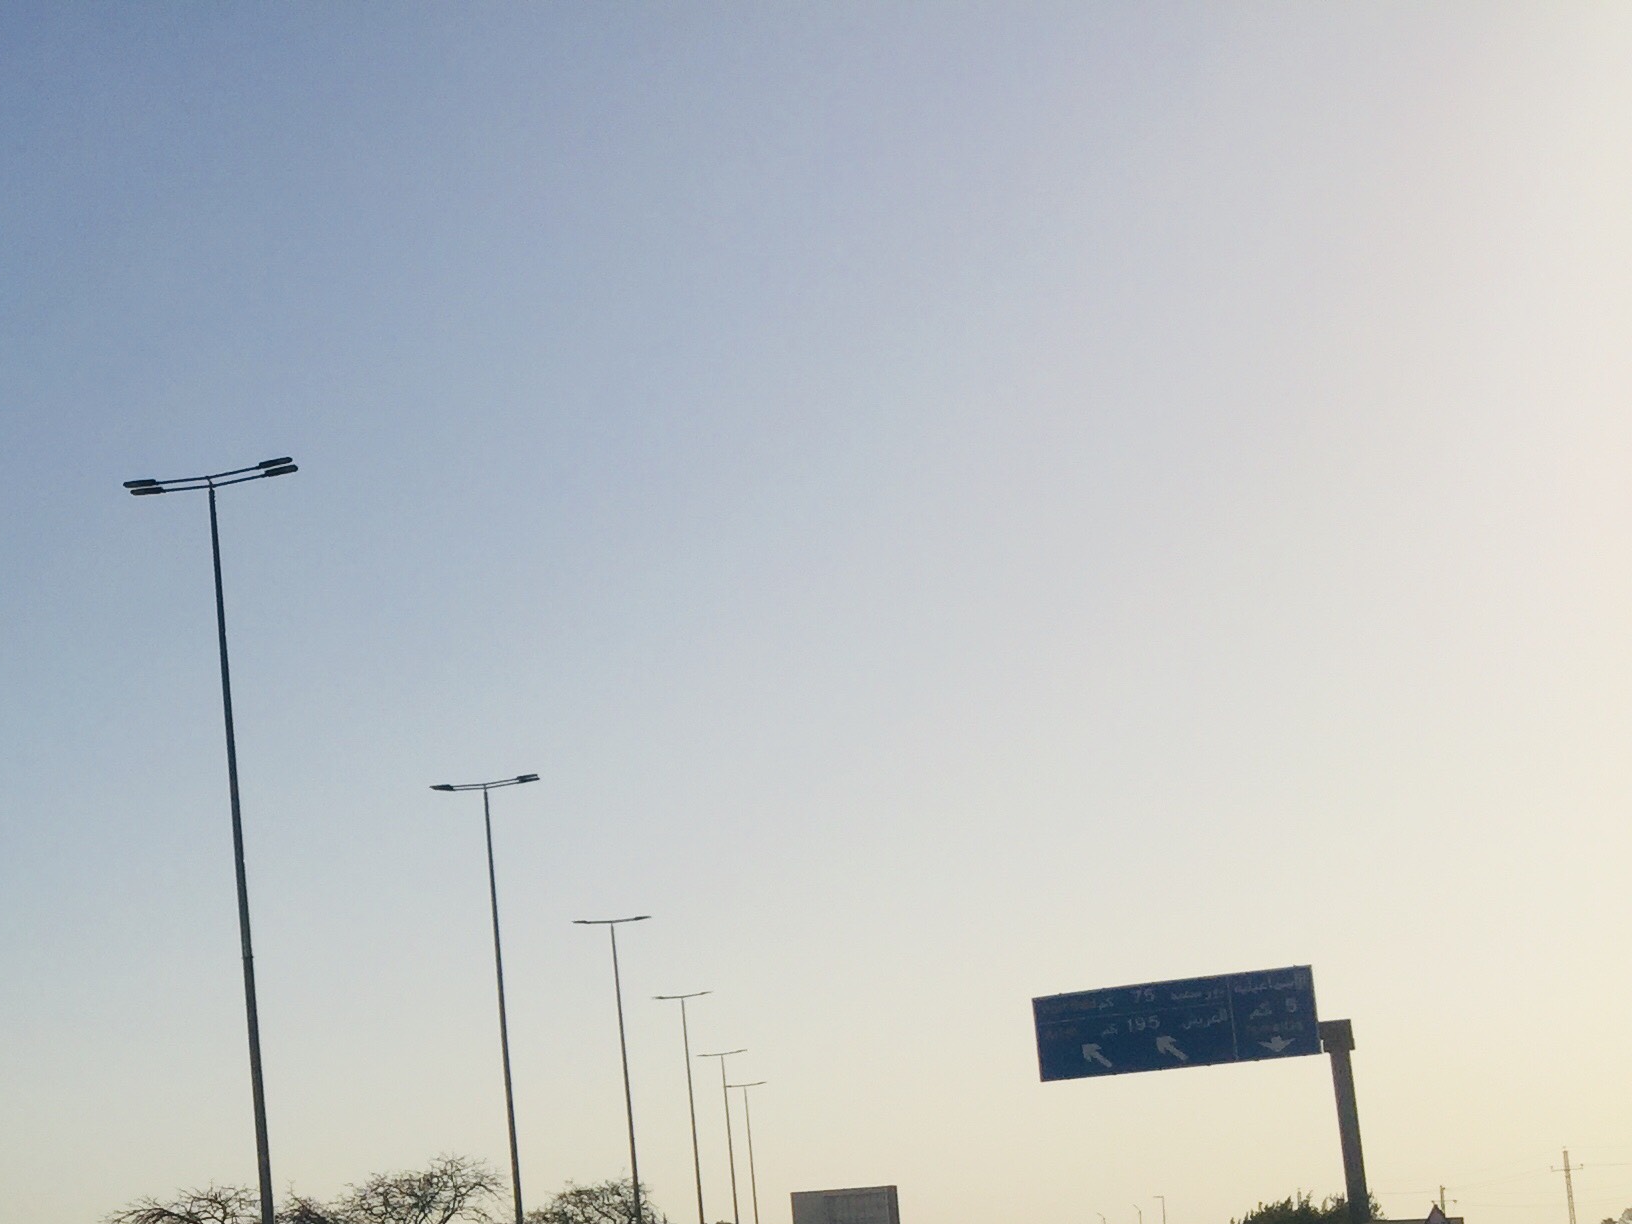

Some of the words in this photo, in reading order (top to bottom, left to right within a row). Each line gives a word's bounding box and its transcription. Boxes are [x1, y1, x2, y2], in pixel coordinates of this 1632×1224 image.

[1133, 989, 1156, 1003] 75
[1285, 997, 1298, 1013] 5
[1127, 1014, 1161, 1033] 195
